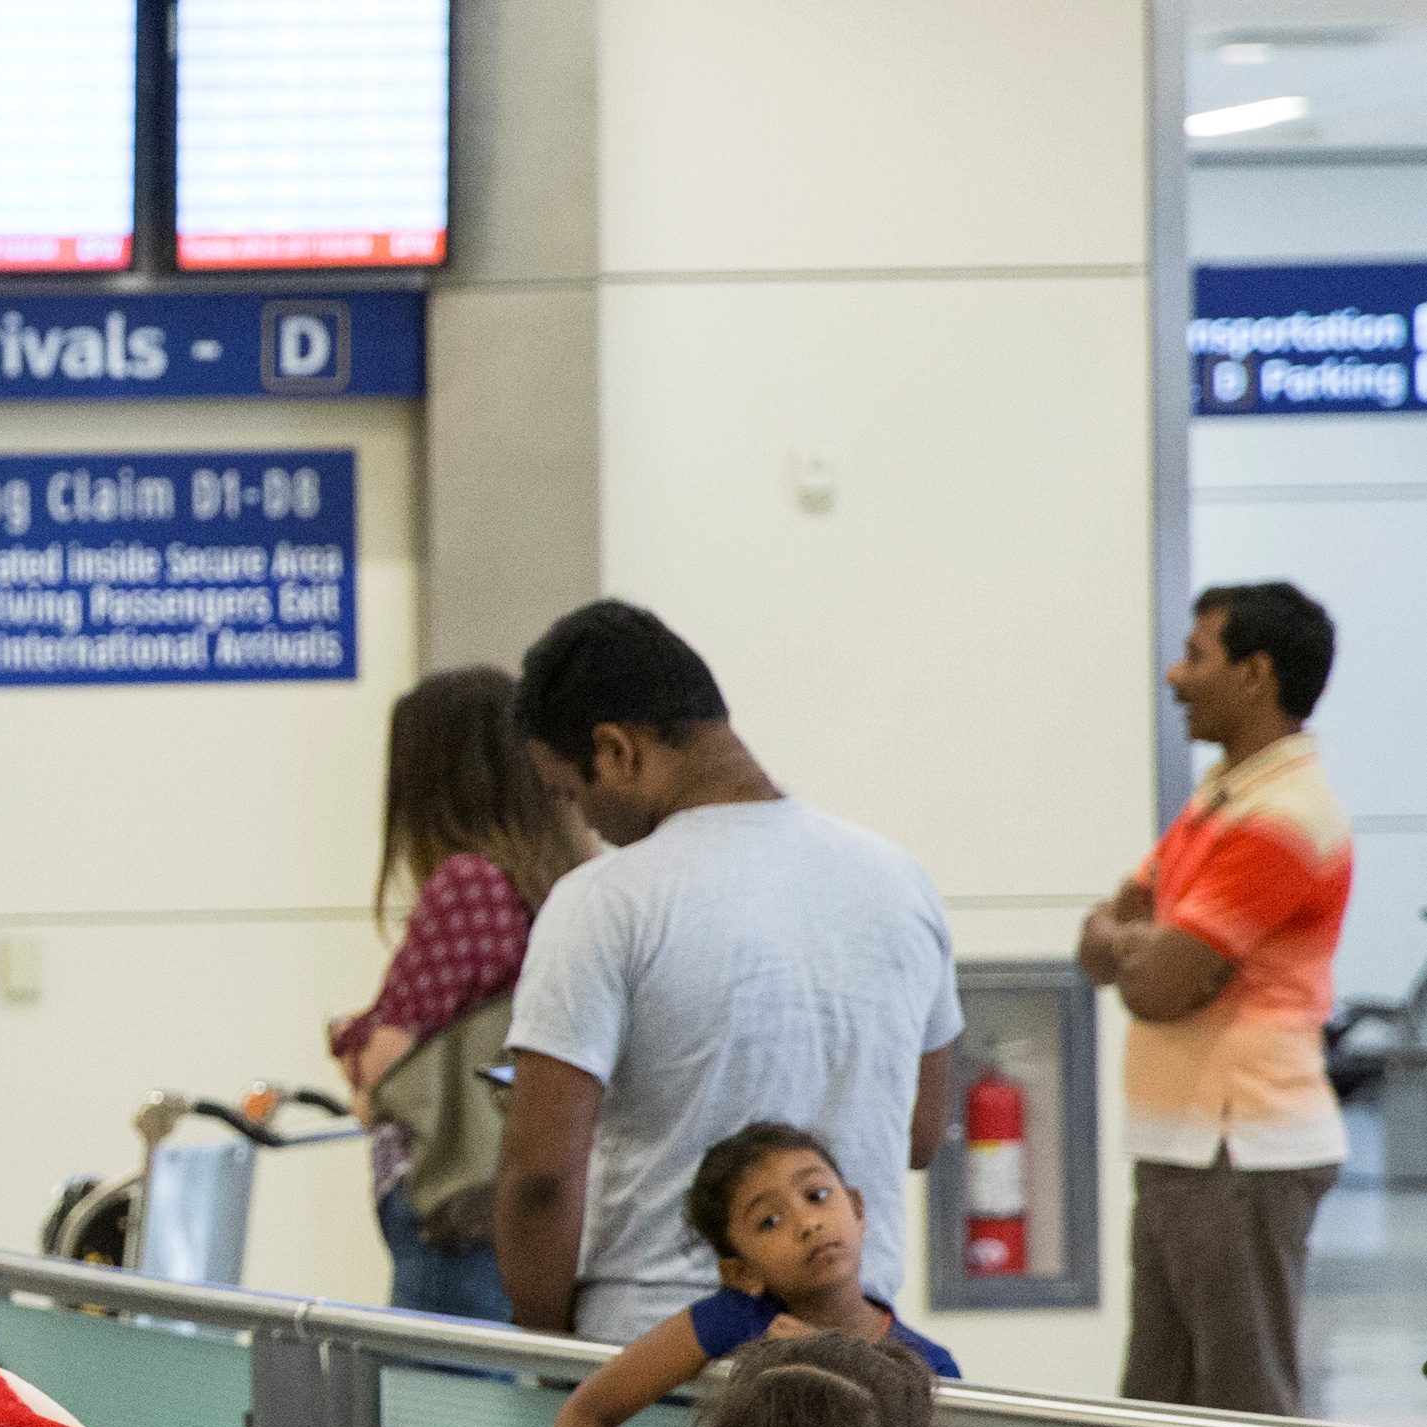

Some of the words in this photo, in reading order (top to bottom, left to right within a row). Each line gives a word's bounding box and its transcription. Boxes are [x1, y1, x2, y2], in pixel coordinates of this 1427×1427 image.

[280, 317, 330, 376] D
[1260, 357, 1408, 408] Parking
[47, 467, 175, 522] Claim
[165, 542, 269, 583] Secure
[272, 540, 345, 580] Area
[89, 585, 273, 630] Passengers
[214, 624, 344, 668] Arrivals
